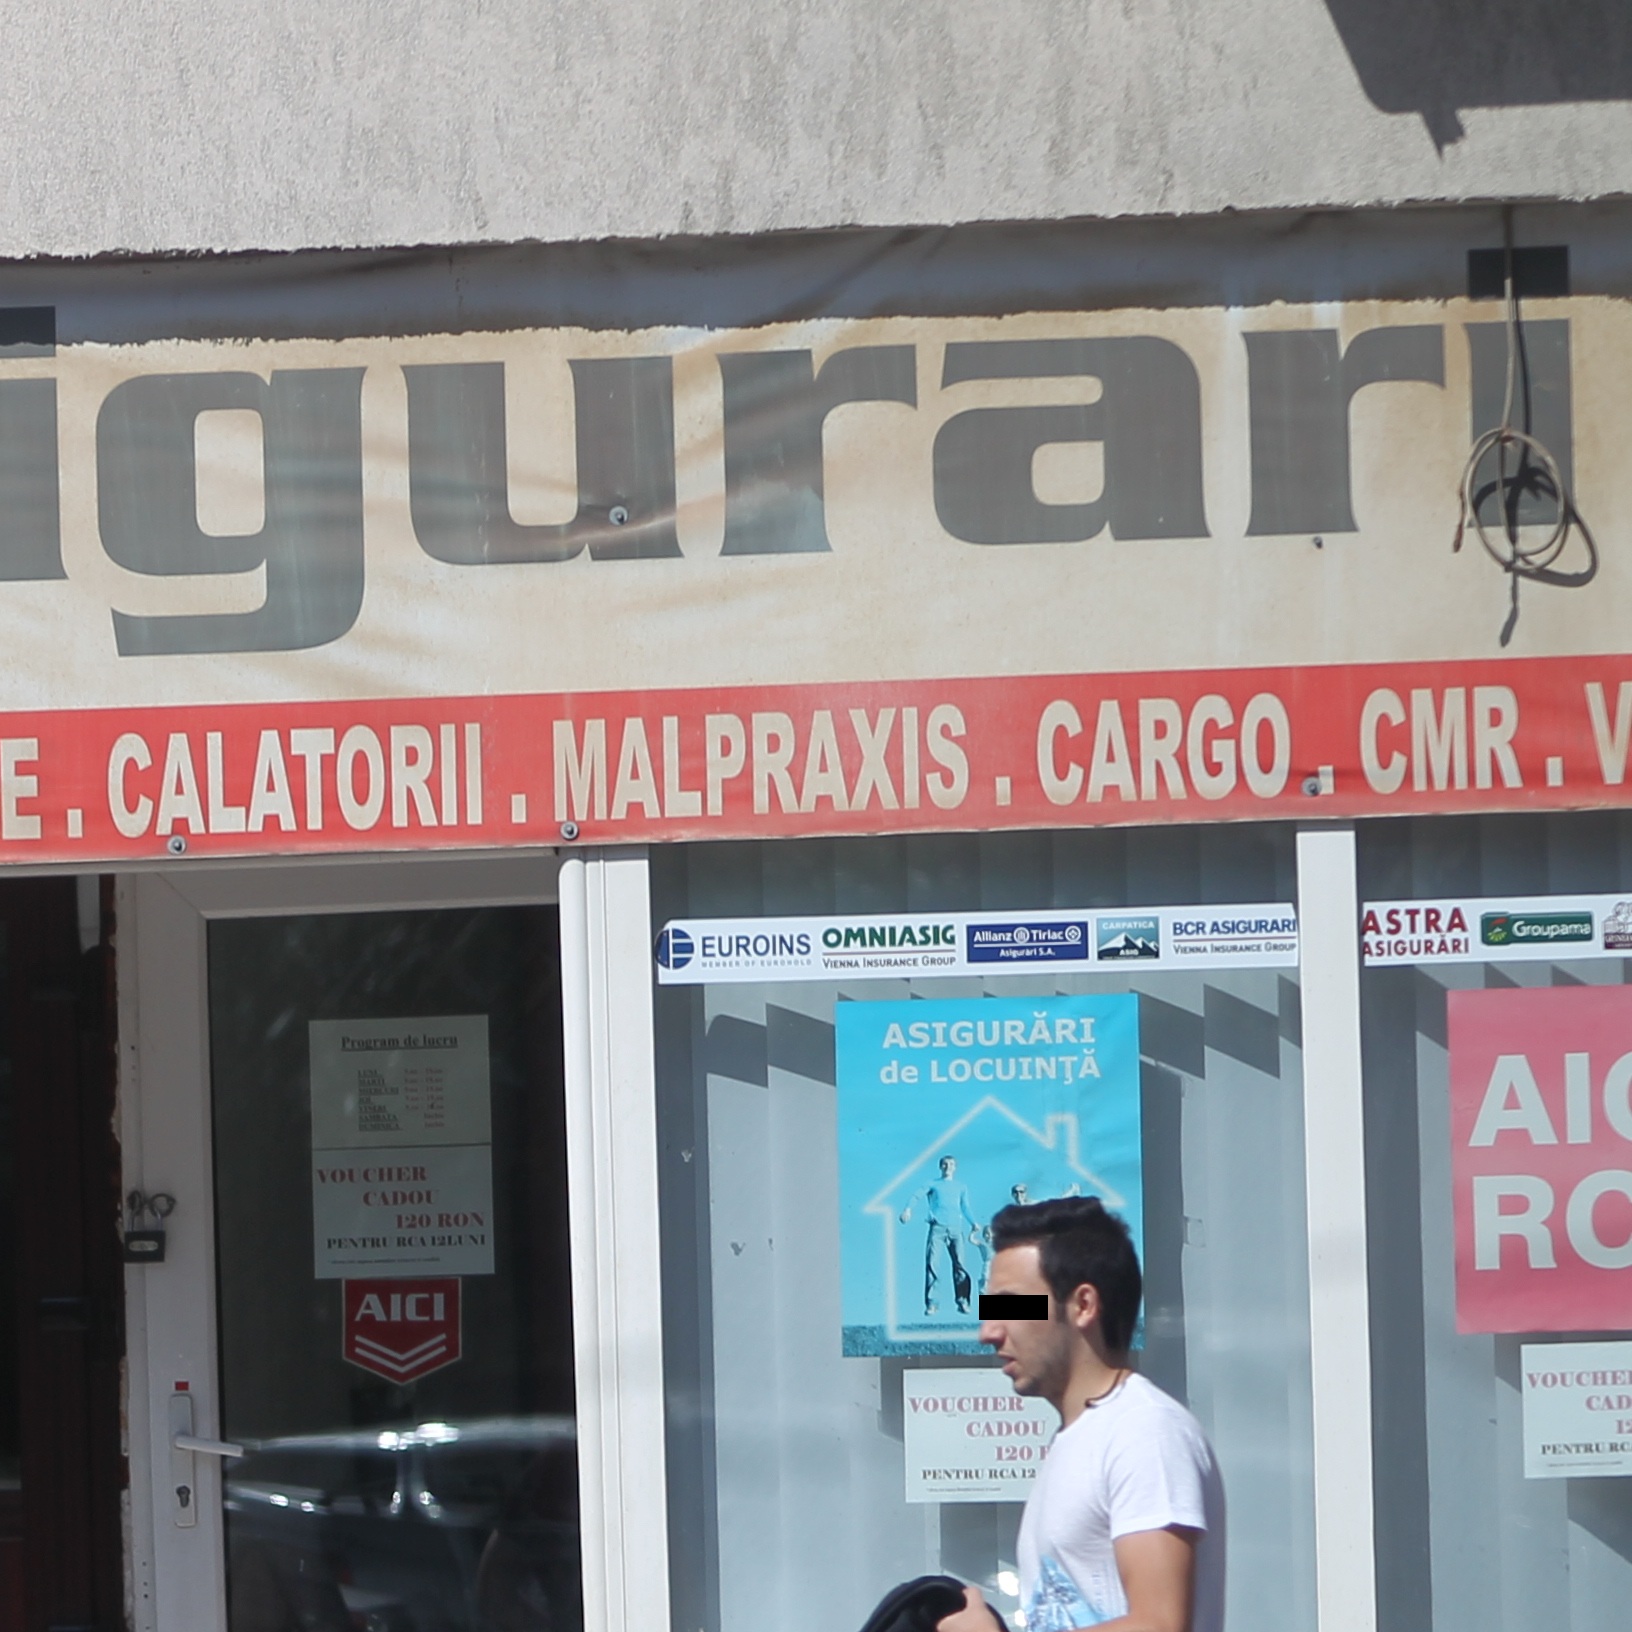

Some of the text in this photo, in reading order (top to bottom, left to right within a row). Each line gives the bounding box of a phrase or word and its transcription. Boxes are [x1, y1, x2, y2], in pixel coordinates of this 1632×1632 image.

[106, 720, 482, 838] CALATORII
[551, 703, 971, 824] MALPRAXIS
[1036, 692, 1294, 804] CARGO
[1358, 684, 1524, 795] CMR
[1102, 920, 1155, 930] CARPATICA
[1172, 921, 1207, 936] BCR
[1360, 906, 1468, 936] ASTRA
[1512, 920, 1591, 939] Groupama
[822, 924, 956, 948] OMNIASIG
[973, 929, 1013, 942] Allianz
[701, 933, 811, 958] EUROINS
[1363, 935, 1470, 957] ASIGURĂRI
[881, 1010, 1096, 1050] ASIGURĂRI
[340, 1032, 458, 1052] Program de lucru
[879, 1058, 920, 1085] de
[316, 1166, 428, 1184] VOUCHER
[363, 1190, 440, 1207] CADOU
[395, 1211, 485, 1230] 120 RON
[326, 1237, 391, 1250] PENTRU
[395, 1236, 425, 1248] RCA
[354, 1292, 446, 1322] AICI
[1526, 1369, 1632, 1388] VOUCHE
[909, 1396, 1025, 1413] VOUCHER
[965, 1420, 1047, 1438] CADOU
[994, 1445, 1033, 1461] 120
[1540, 1442, 1605, 1456] PENTRU
[922, 1468, 984, 1481] PENTRU
[988, 1467, 1019, 1480] RCA
